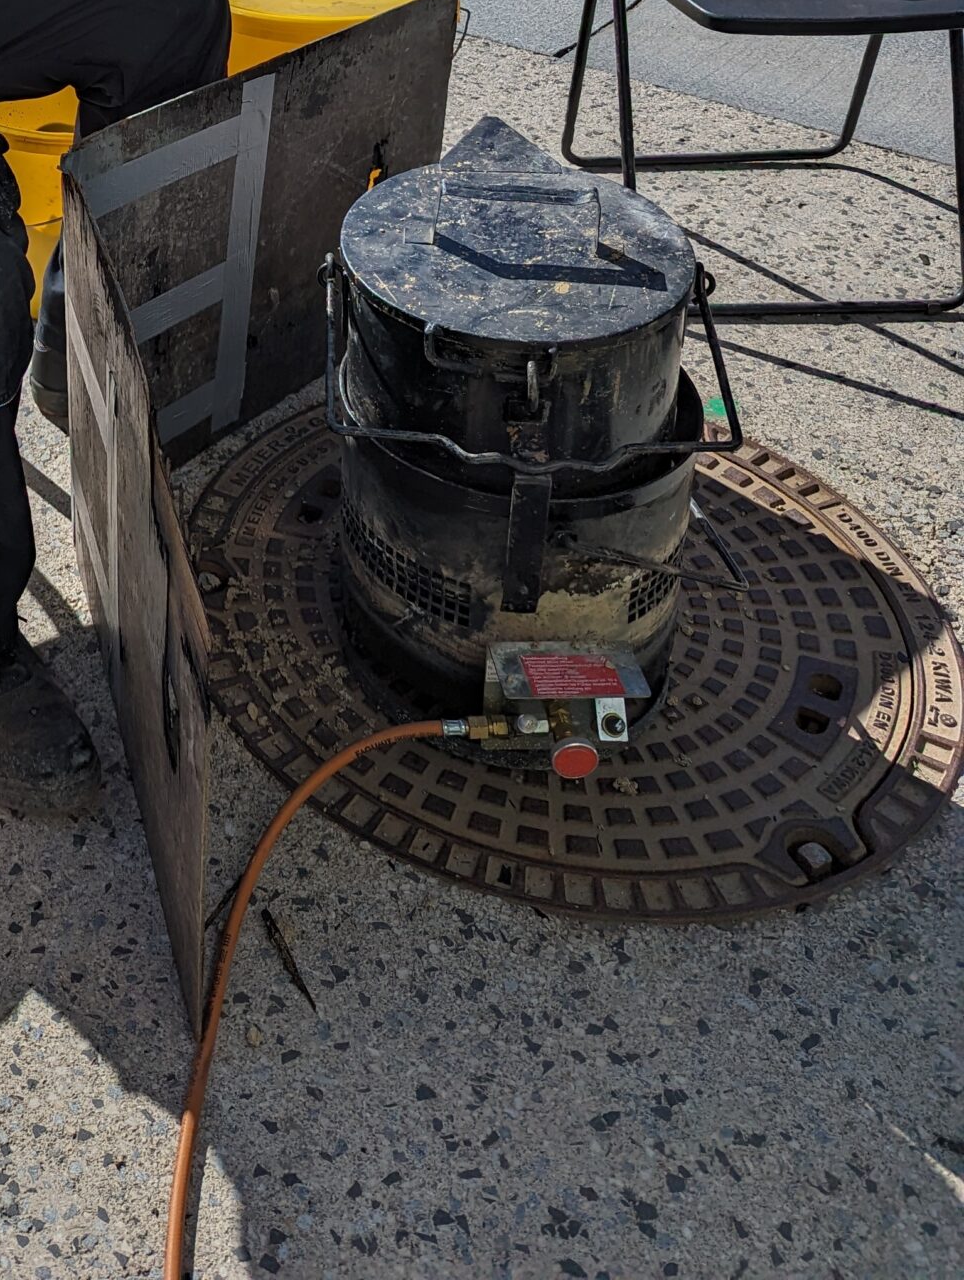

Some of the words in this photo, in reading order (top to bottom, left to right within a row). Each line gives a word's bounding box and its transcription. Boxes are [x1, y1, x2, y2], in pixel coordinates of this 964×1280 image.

[230, 439, 285, 487] MEIER
[837, 513, 878, 547] D400
[875, 551, 904, 576] DIN
[897, 582, 921, 603] EN
[932, 660, 953, 703] KIWA
[878, 686, 895, 709] DIN
[873, 711, 892, 731] EN
